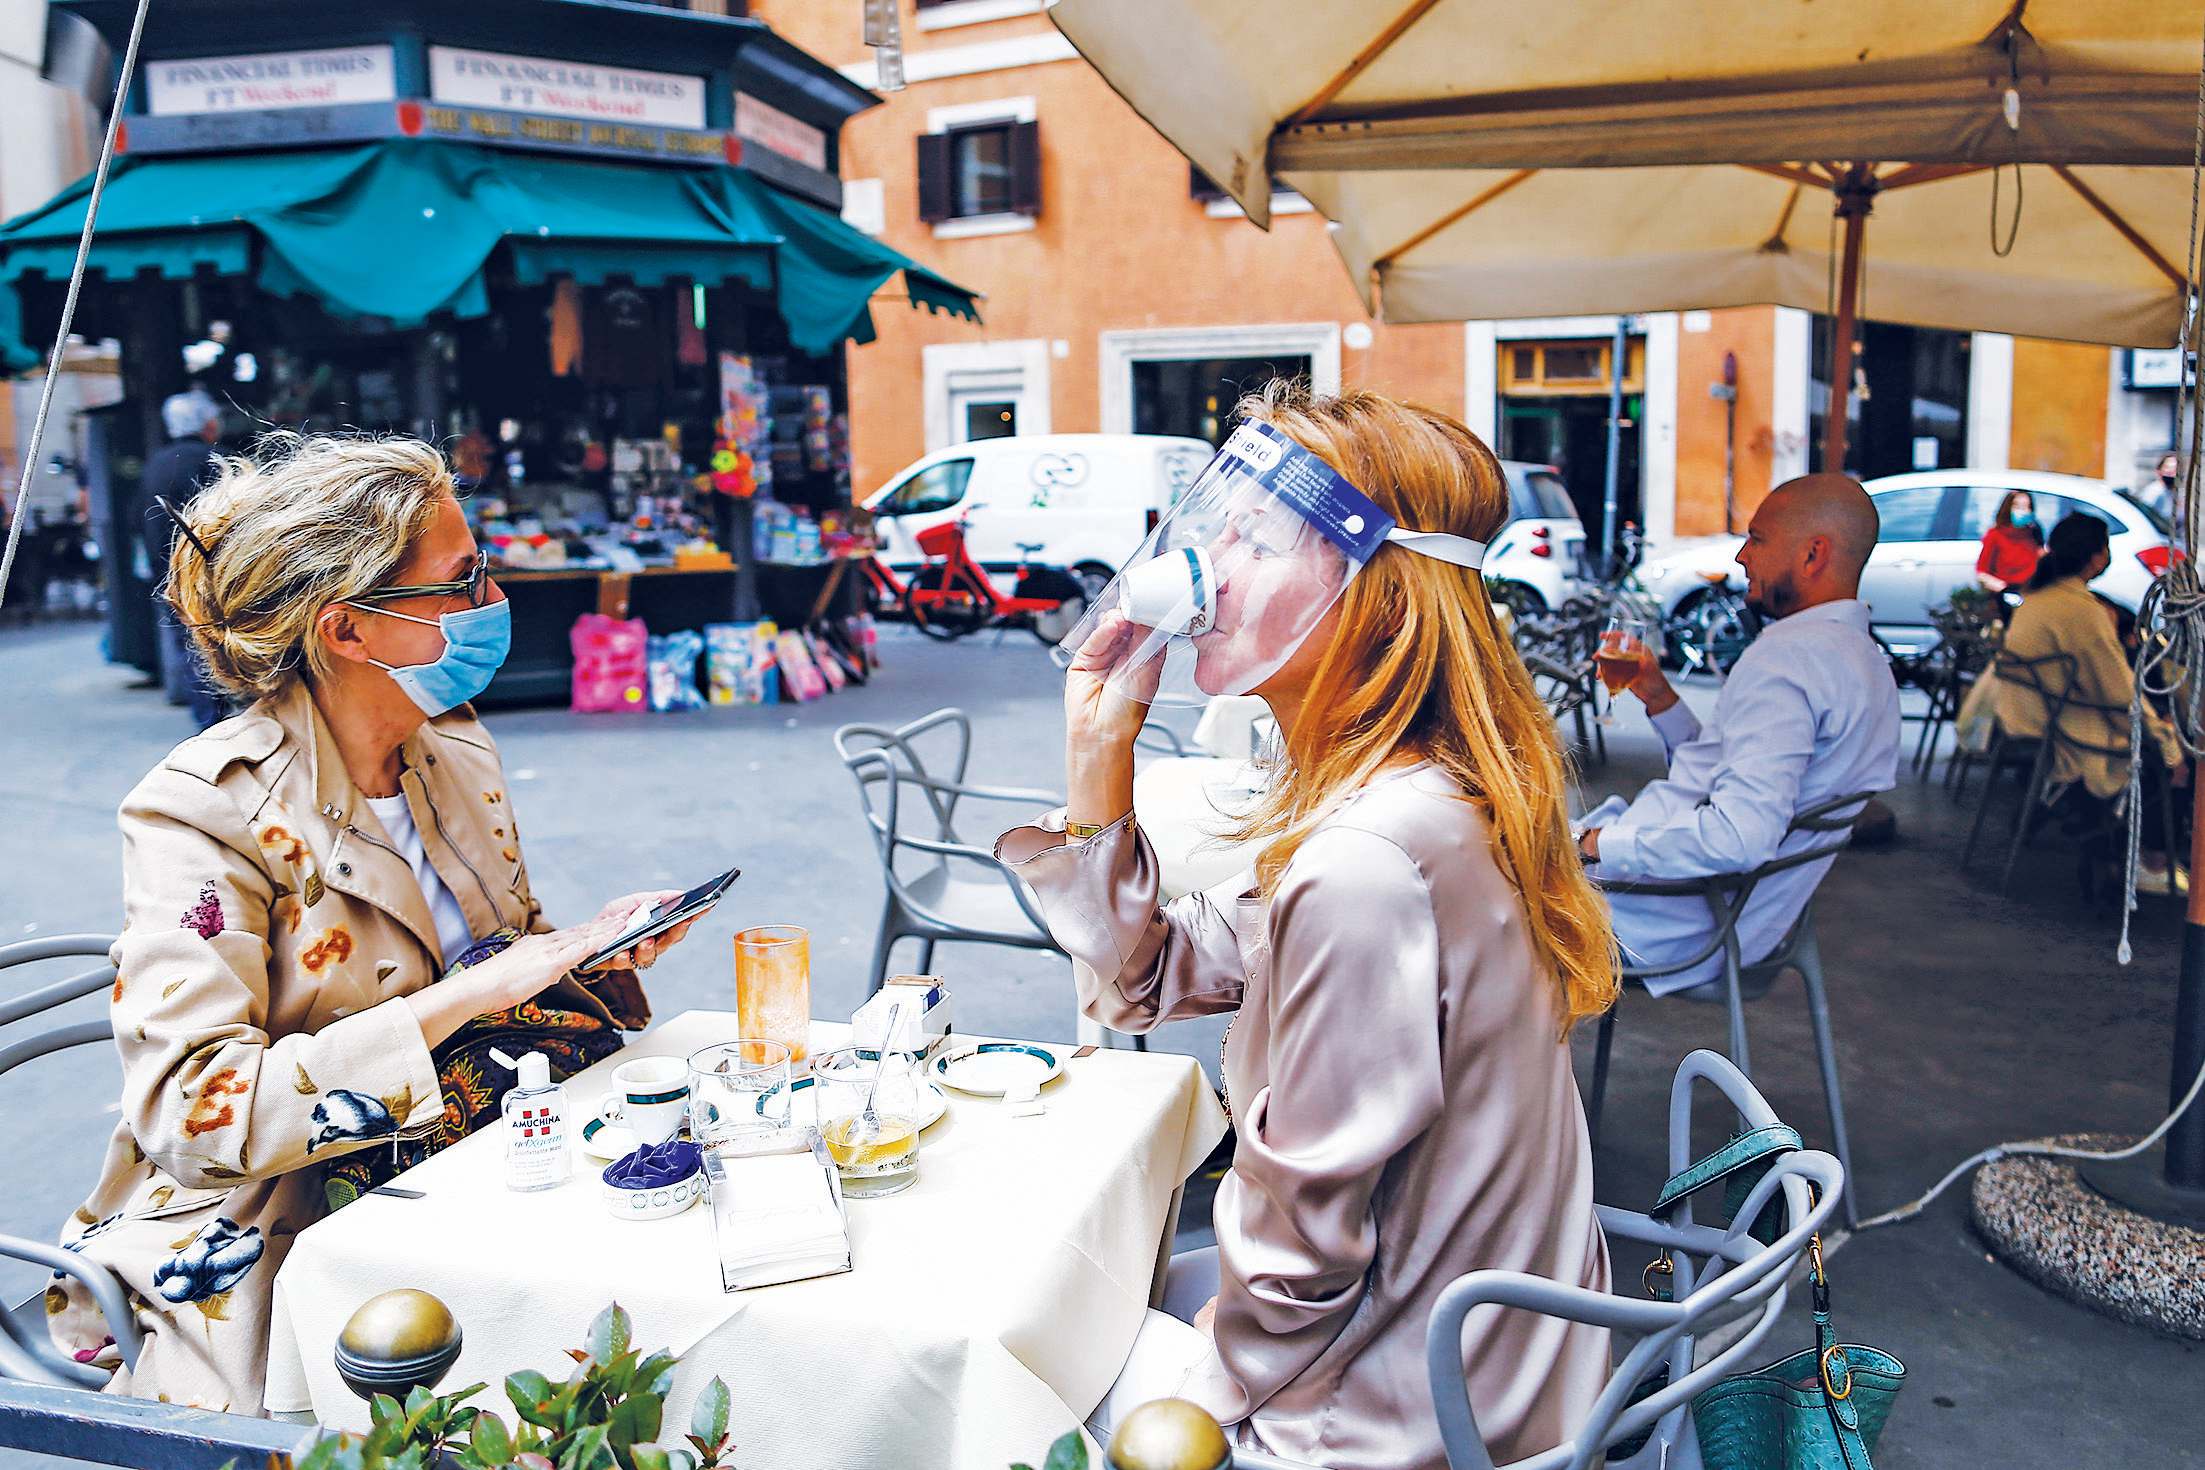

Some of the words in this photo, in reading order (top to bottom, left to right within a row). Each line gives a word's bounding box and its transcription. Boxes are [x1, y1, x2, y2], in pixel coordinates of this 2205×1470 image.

[166, 59, 290, 85] FINANCIAL
[301, 54, 376, 80] TIMES
[454, 55, 597, 89] FINANCIAL
[608, 75, 686, 100] TIMES
[206, 87, 236, 105] FT
[500, 84, 534, 104] FT
[512, 1115, 560, 1128] AMUCHINA
